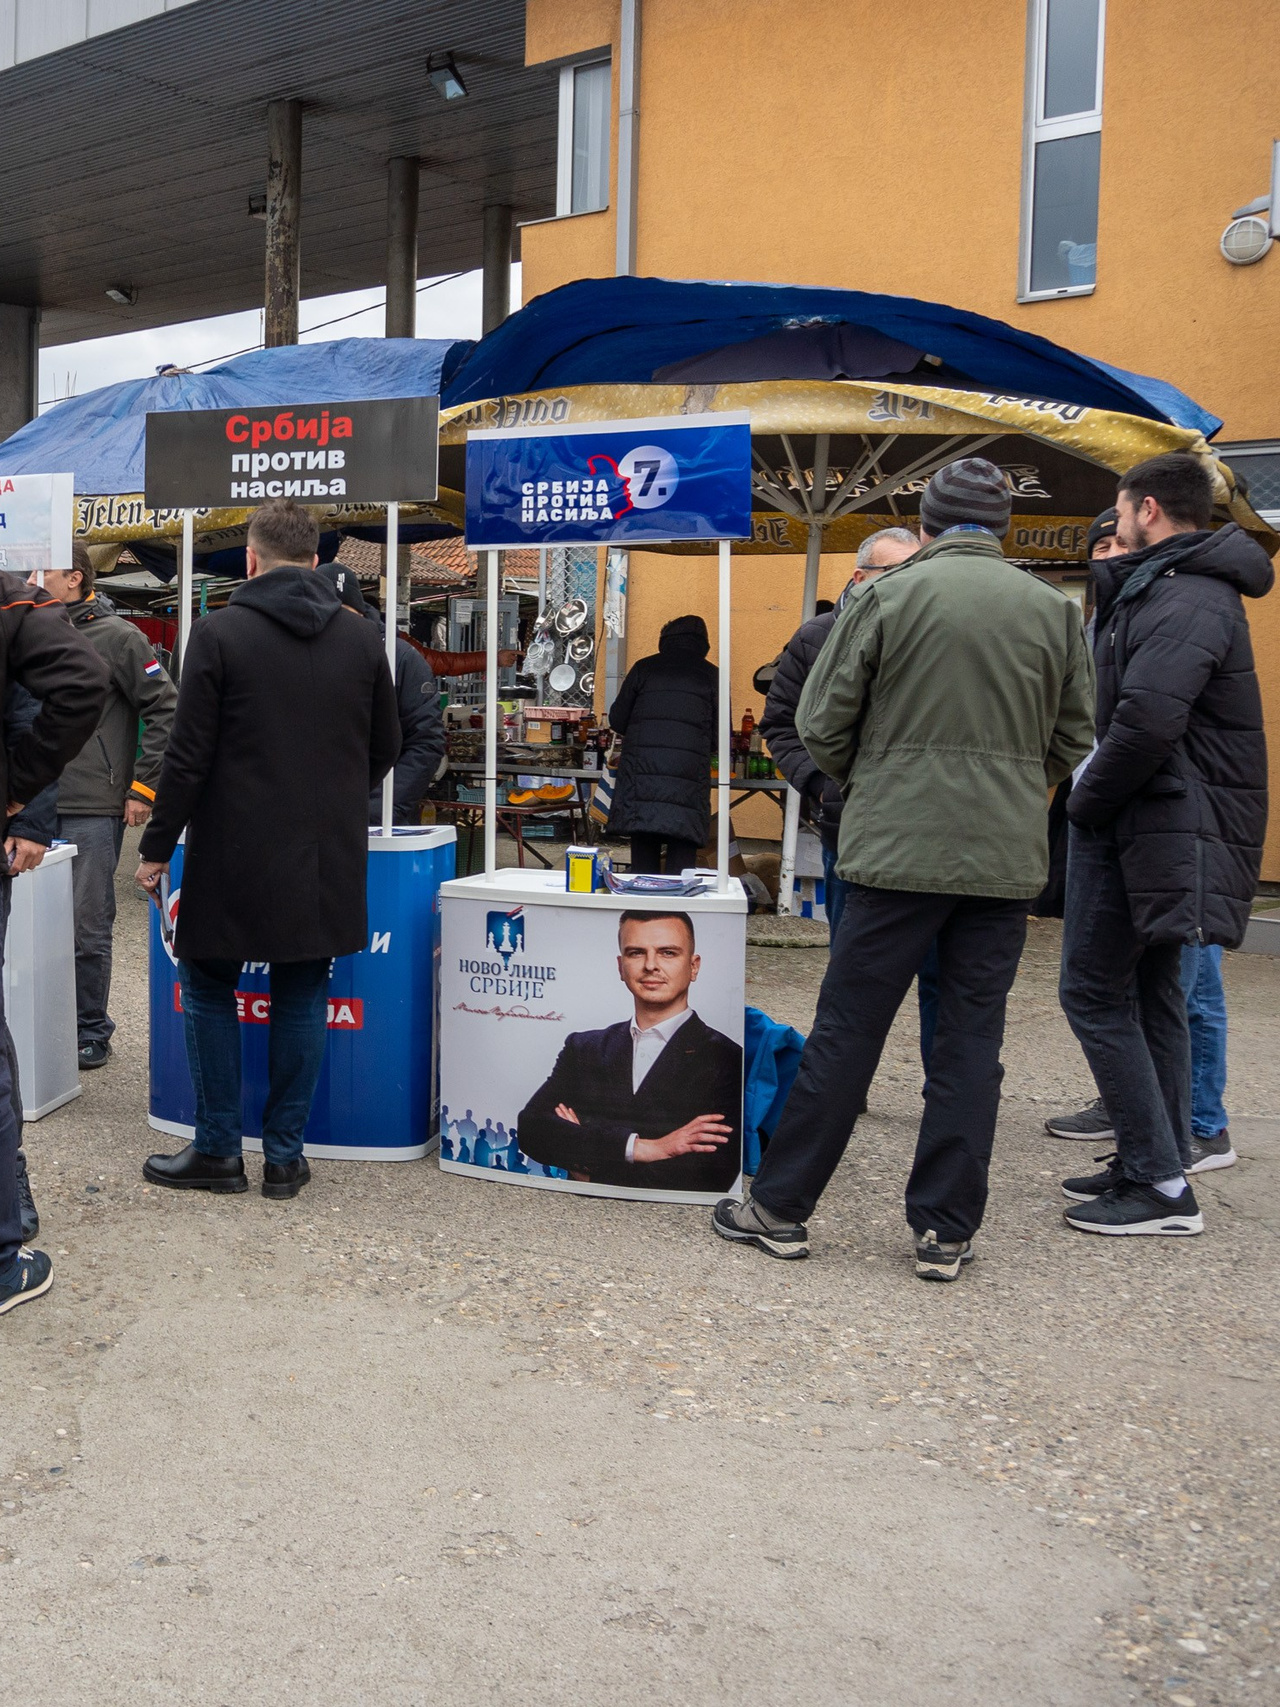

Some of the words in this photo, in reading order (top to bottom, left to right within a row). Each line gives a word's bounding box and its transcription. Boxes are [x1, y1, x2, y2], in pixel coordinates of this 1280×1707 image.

[225, 410, 353, 449] Србија
[231, 450, 346, 478] против
[230, 478, 347, 499] насиља
[521, 479, 609, 496] СРБИЈА
[521, 493, 609, 509] ПРОТИВ
[521, 507, 613, 523] НАСИЉА
[459, 958, 501, 976] НОВО
[508, 964, 556, 982] ЛИЦЕ
[470, 976, 544, 1001] СРБИЈЕ
